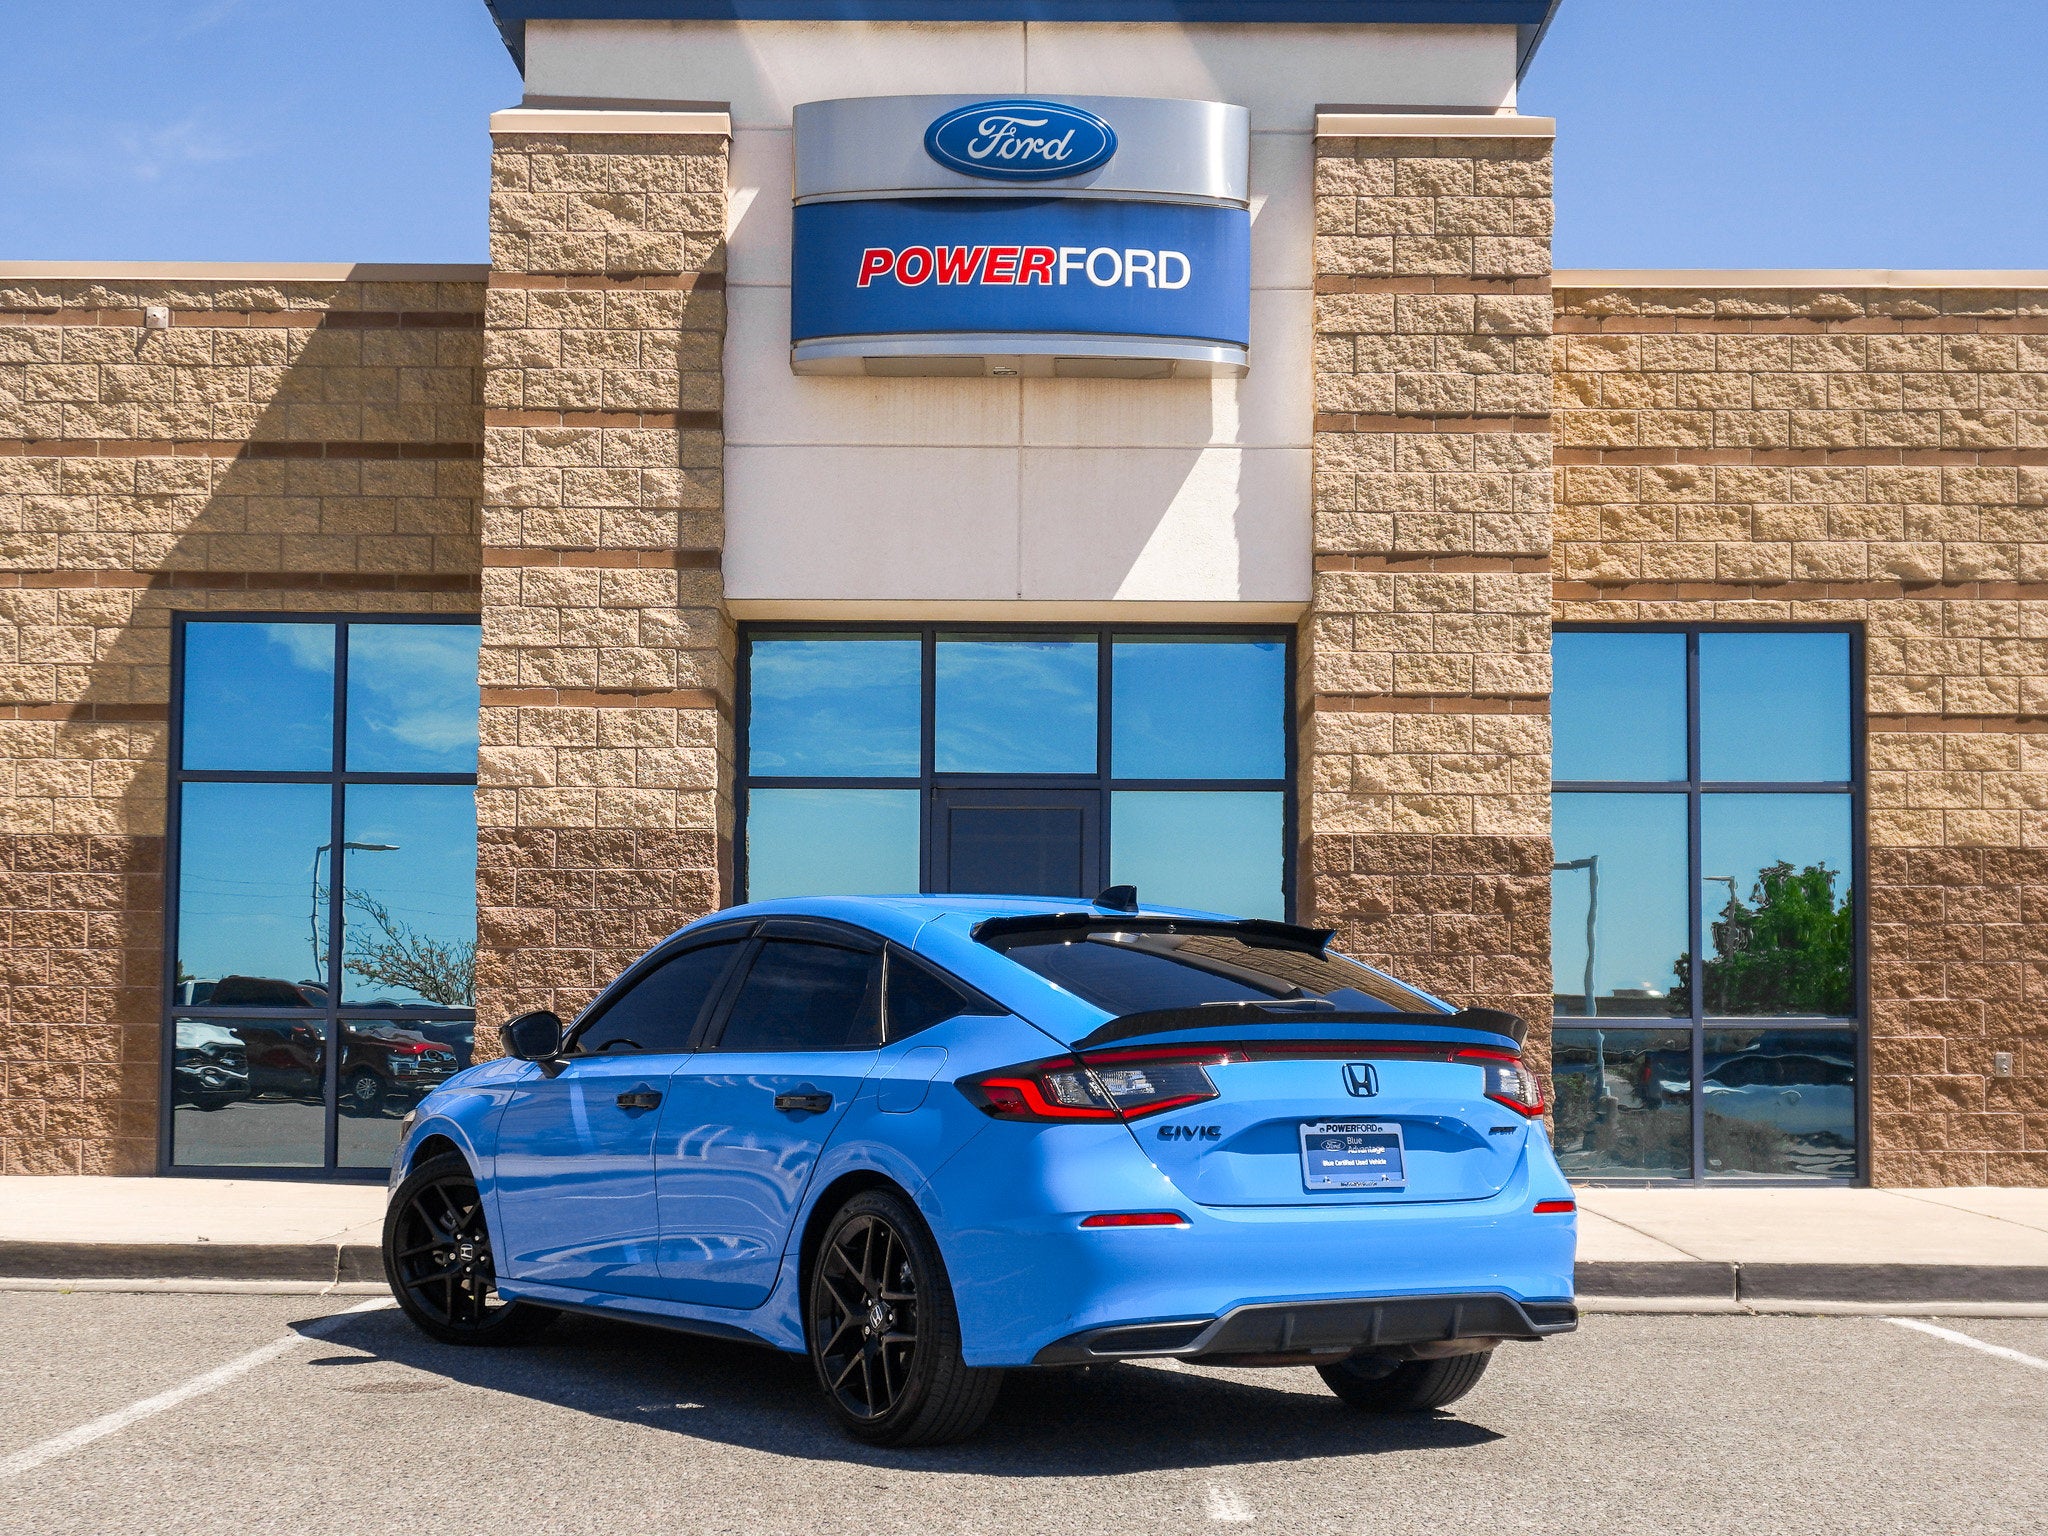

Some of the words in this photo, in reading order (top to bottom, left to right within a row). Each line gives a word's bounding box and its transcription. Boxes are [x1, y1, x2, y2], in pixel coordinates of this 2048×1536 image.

[967, 115, 1075, 161] Ford
[856, 245, 1191, 290] POWERFORD
[1157, 1125, 1222, 1140] CIVIC
[1326, 1124, 1378, 1132] POWERFORD
[1347, 1136, 1363, 1145] Blue
[1347, 1146, 1386, 1154] Advantage
